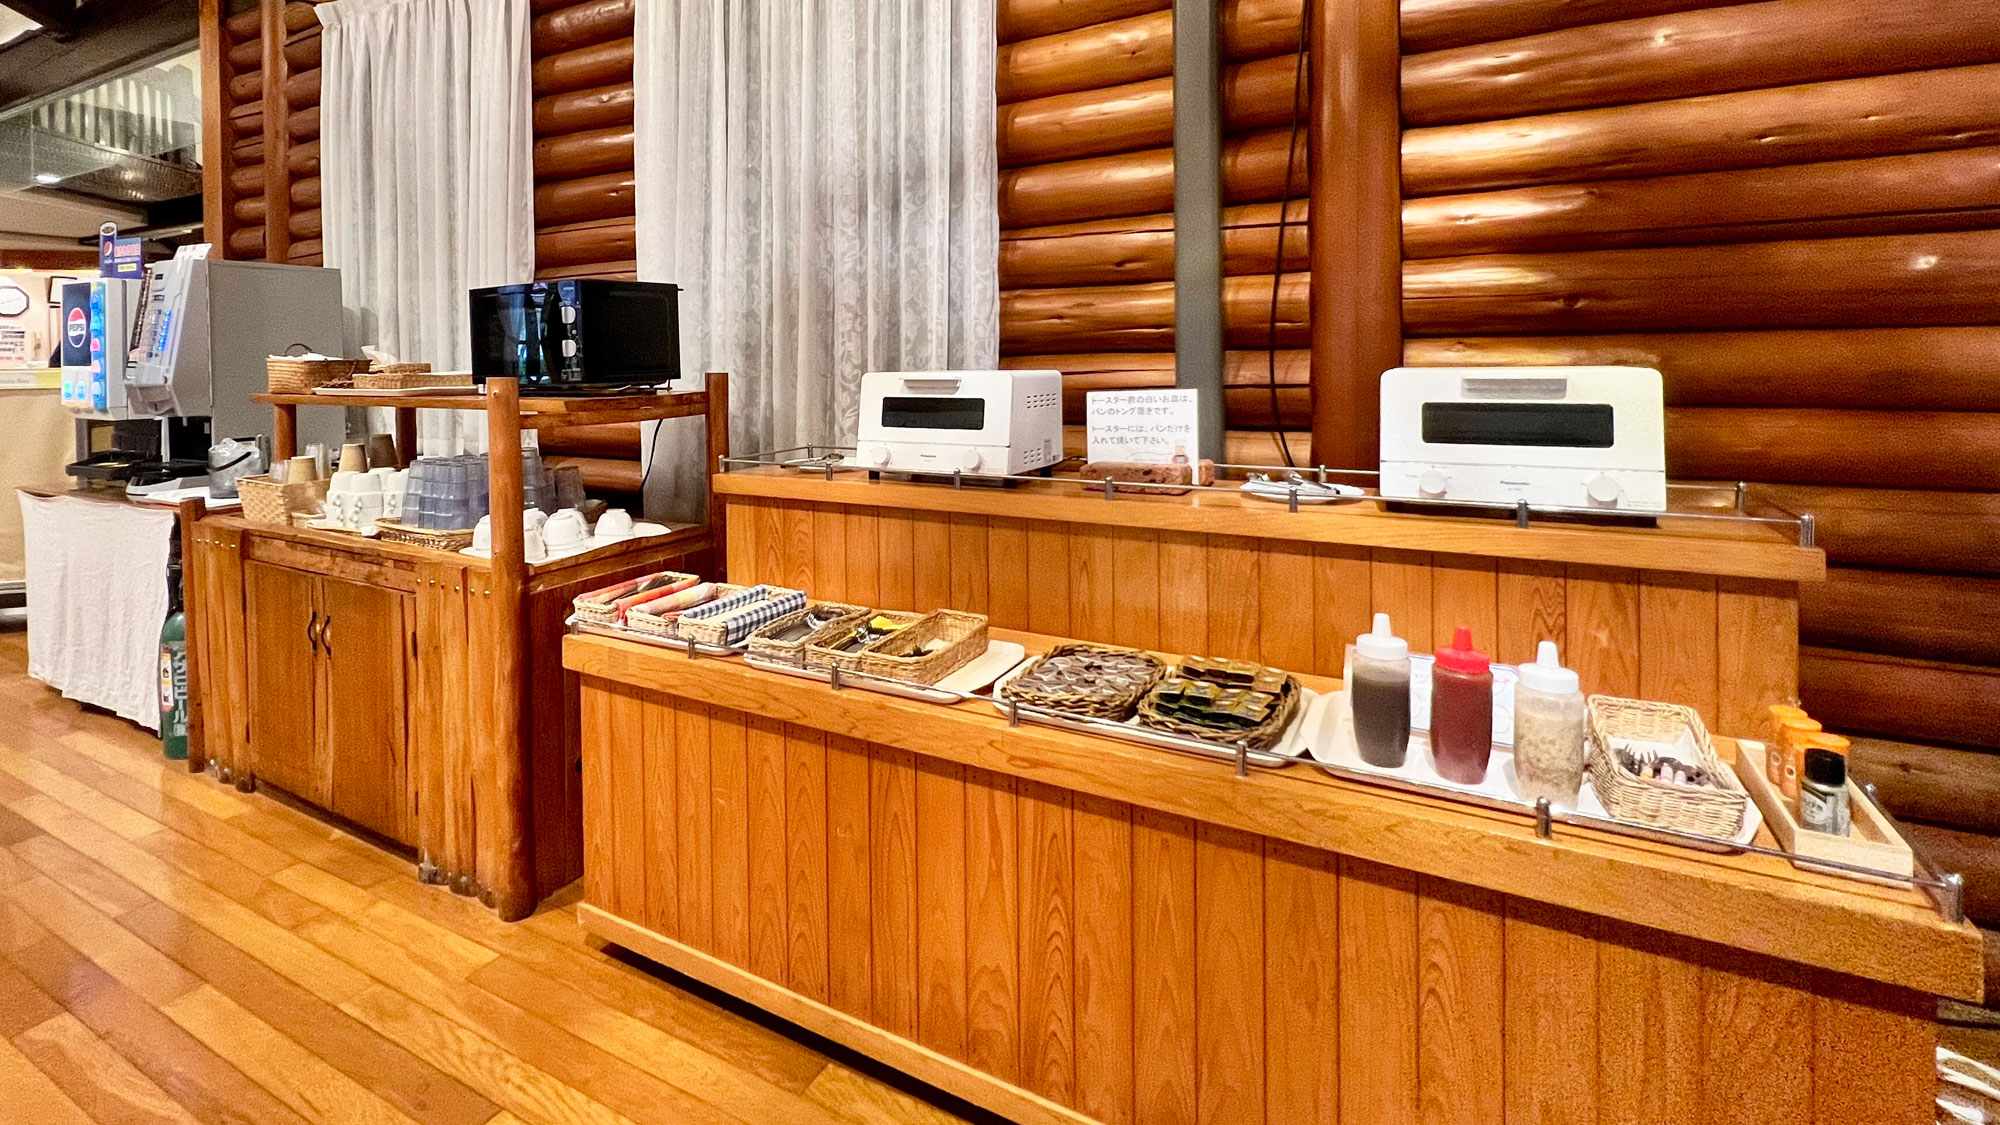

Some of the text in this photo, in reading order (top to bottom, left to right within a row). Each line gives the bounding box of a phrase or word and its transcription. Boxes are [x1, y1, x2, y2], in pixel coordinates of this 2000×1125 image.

[69, 323, 85, 332] PEPSI
[1092, 395, 1193, 404] トースター前の白いお皿は、
[1092, 407, 1174, 416] パンのトング置きです。
[1092, 424, 1191, 433] トースターには、パンだけを
[1092, 436, 1169, 445] 入れて焼いて下さい。
